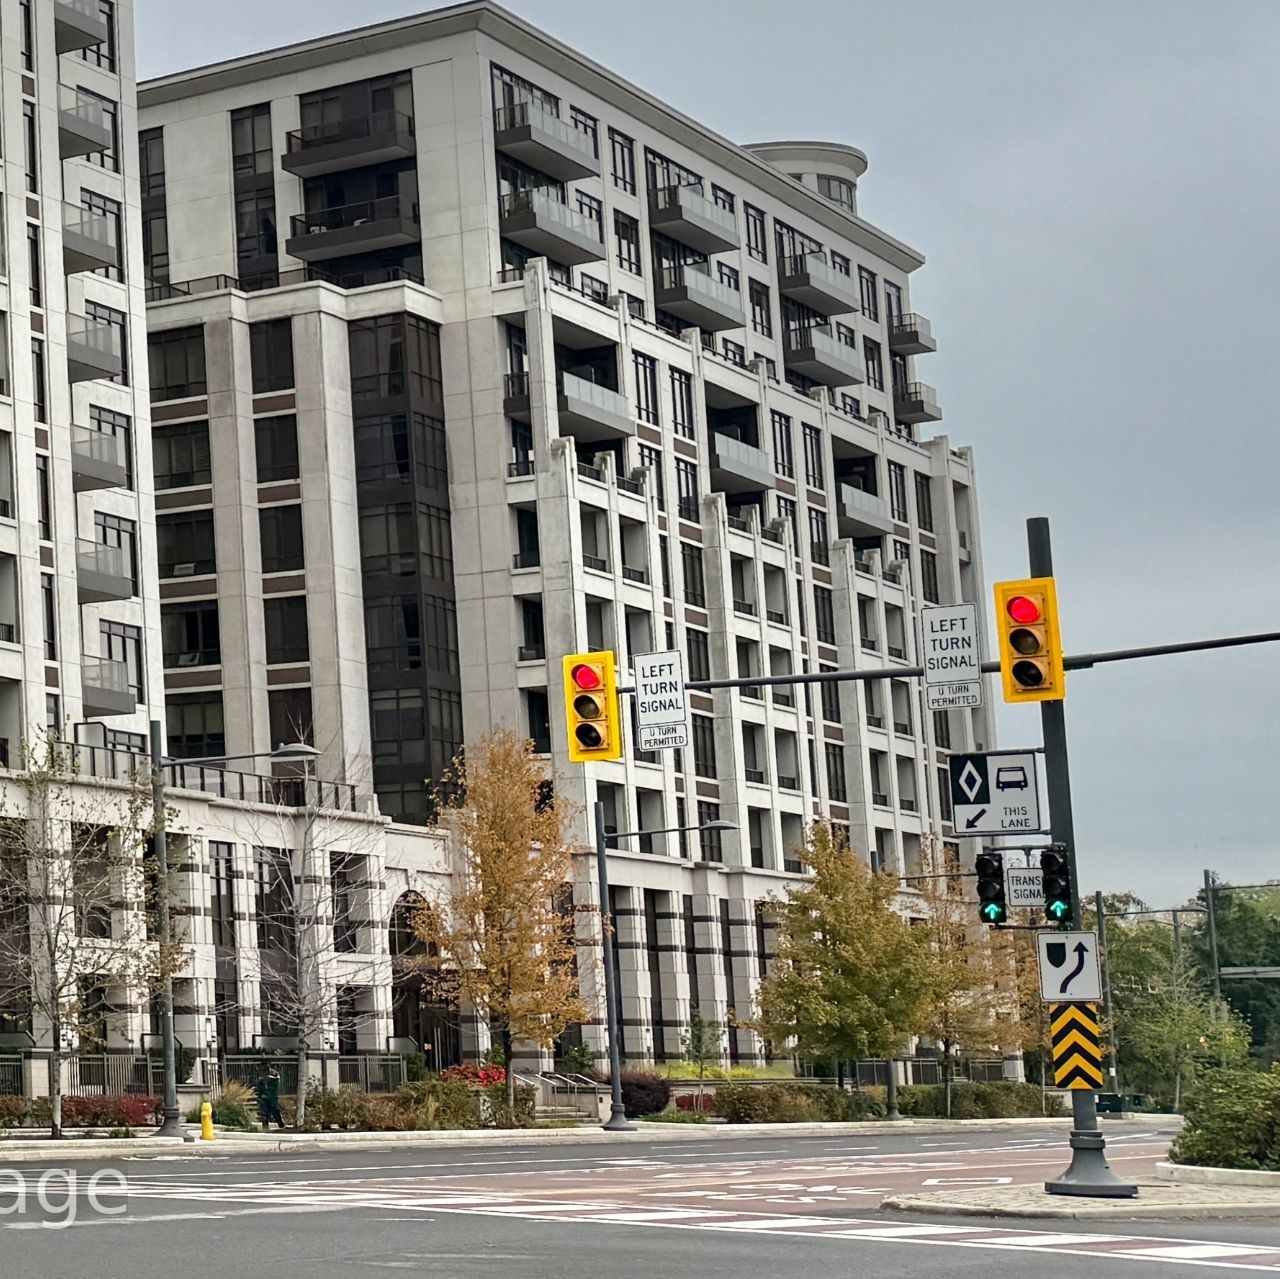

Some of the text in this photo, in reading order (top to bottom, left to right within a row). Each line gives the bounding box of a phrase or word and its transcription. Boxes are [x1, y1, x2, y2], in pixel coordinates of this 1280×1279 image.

[930, 617, 967, 633] LEFT
[930, 636, 971, 652] TURN
[927, 655, 977, 670] SIGNAL
[642, 663, 674, 678] LEFT
[642, 681, 678, 696] TURN
[938, 685, 969, 695] U TURN
[640, 698, 683, 713] SIGNAL
[932, 695, 978, 707] PERMITTED
[650, 726, 677, 737] U TURN
[644, 735, 684, 747] PERMITTED
[1003, 806, 1028, 816] THIS
[1001, 819, 1031, 828] LANE
